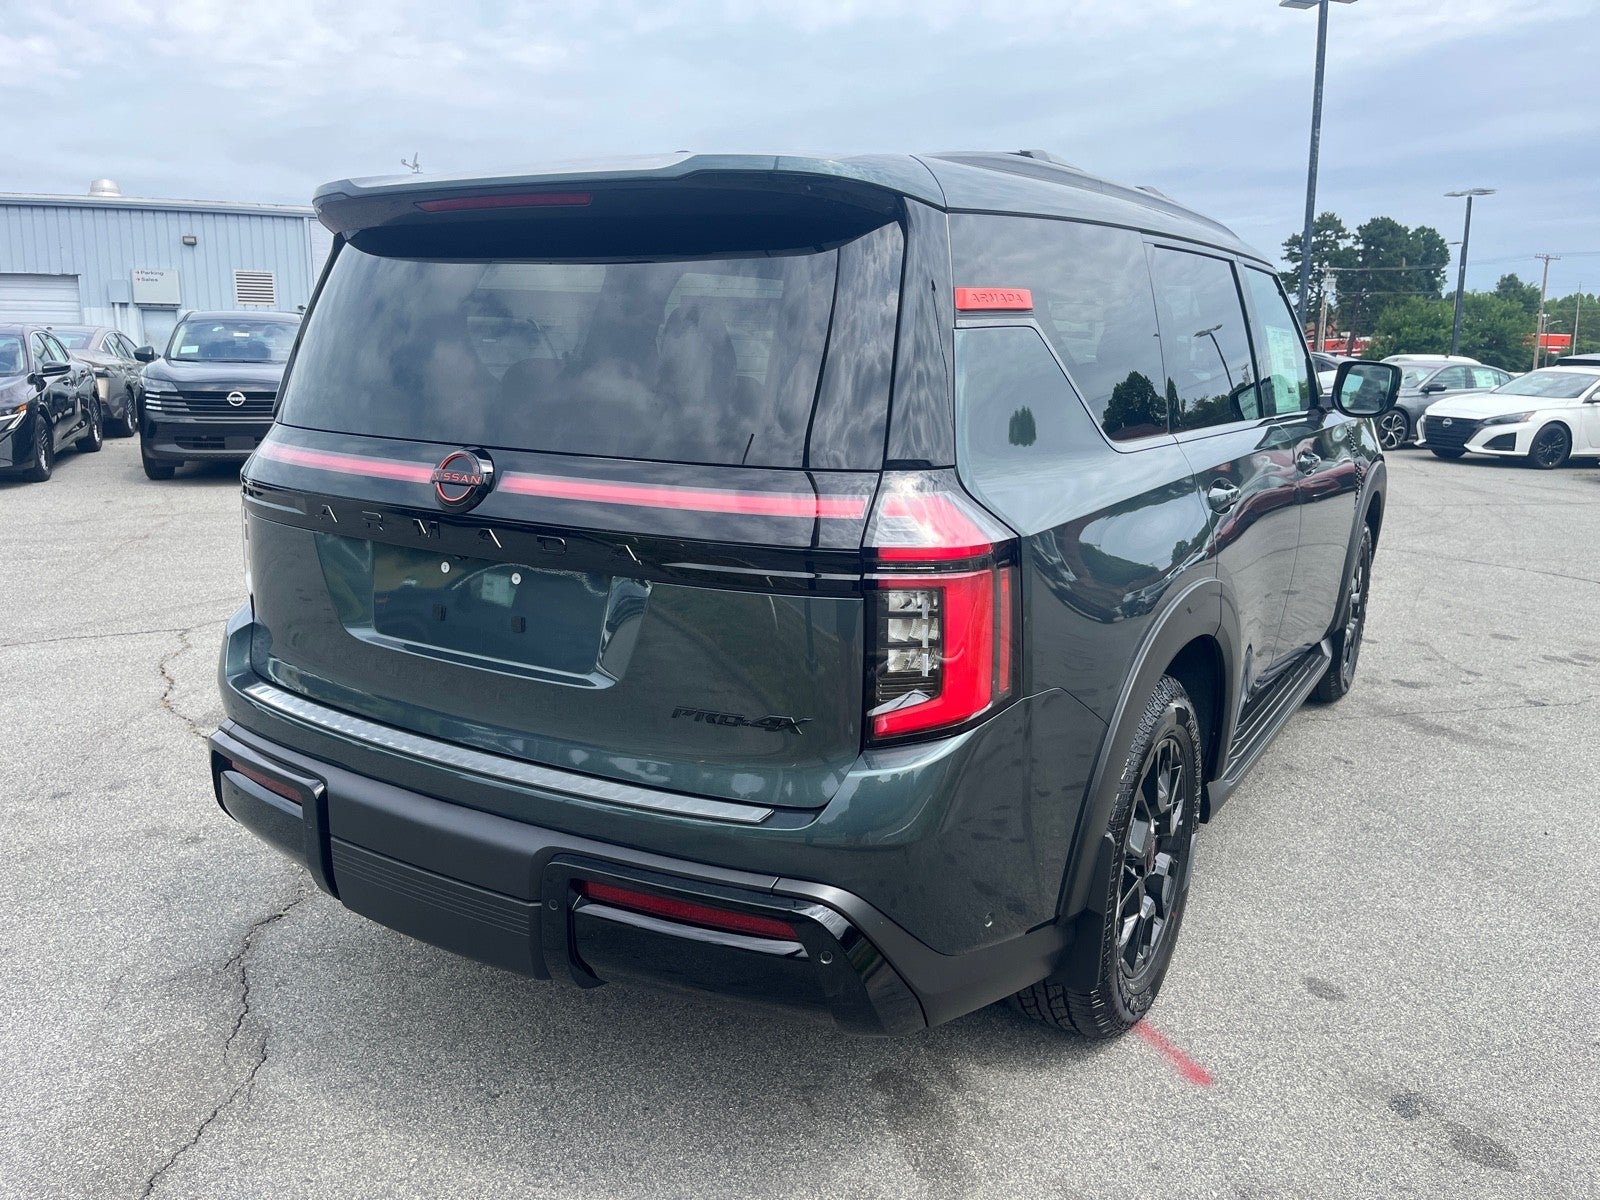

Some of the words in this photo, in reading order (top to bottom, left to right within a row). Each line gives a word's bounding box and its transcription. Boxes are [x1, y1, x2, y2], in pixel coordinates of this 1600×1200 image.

[972, 293, 1024, 303] ARMADA
[433, 472, 481, 484] NISSAN
[314, 503, 643, 566] ARMADA
[671, 705, 815, 735] PRO-4X
